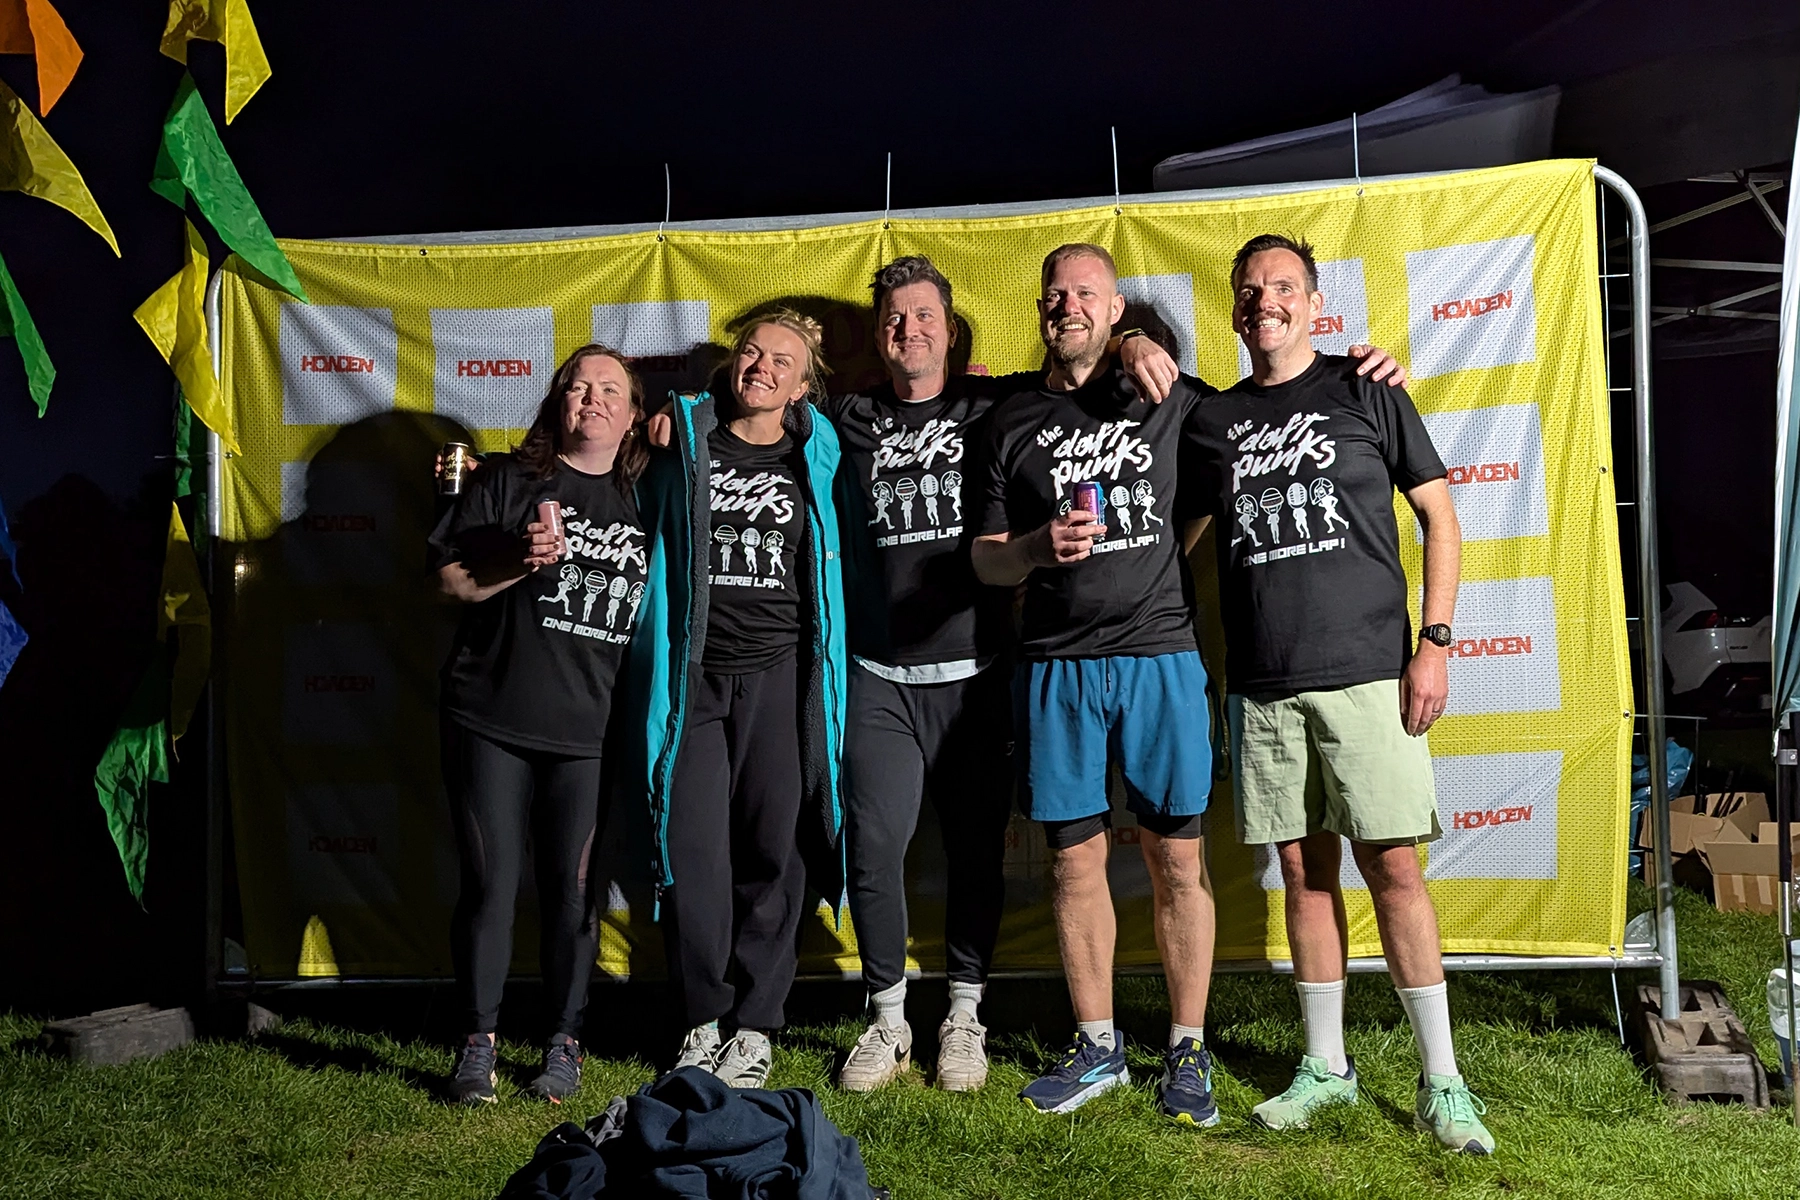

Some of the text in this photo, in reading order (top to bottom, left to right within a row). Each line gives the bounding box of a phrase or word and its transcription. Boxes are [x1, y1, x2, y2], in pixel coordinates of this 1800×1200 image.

[1433, 290, 1513, 321] HOWDEN
[301, 355, 374, 373] HOWDEN
[457, 359, 532, 377] HOWDEN
[872, 417, 894, 435] the
[1227, 419, 1253, 441] the
[1036, 425, 1064, 448] the
[1447, 461, 1520, 486] OWDEN
[560, 506, 577, 518] he
[876, 534, 898, 548] ONE
[900, 529, 936, 544] MORE
[1092, 539, 1128, 555] MORE
[1242, 551, 1267, 567] ONE
[1269, 543, 1307, 561] MORE
[714, 575, 753, 587] MORE
[542, 616, 573, 632] ONE
[573, 623, 608, 641] MORE
[1452, 804, 1533, 830] HOWDEN
